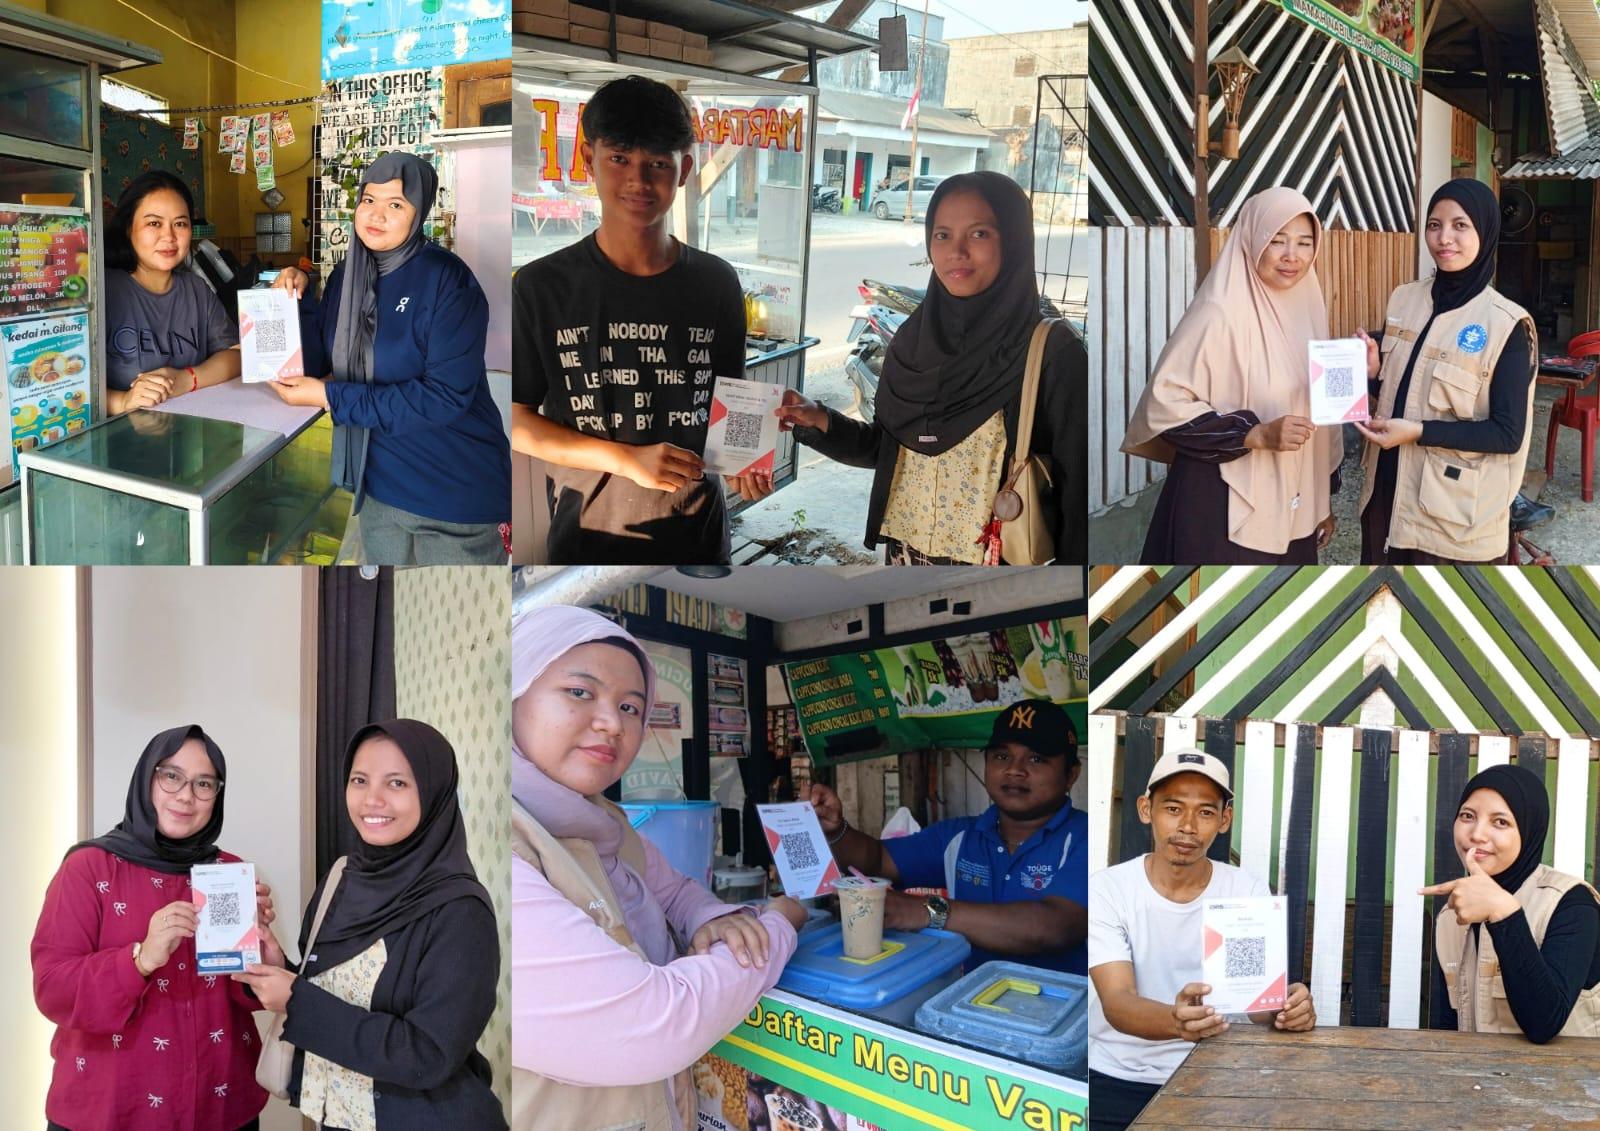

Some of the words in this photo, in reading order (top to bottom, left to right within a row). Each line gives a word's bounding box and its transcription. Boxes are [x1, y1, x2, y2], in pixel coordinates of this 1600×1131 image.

[1293, 0, 1326, 26] MAMAH
[1326, 16, 1351, 42] NABIL
[345, 78, 378, 101] THIS
[382, 71, 432, 96] OFFICE
[354, 102, 380, 111] ARE
[345, 113, 369, 127] ARE
[361, 122, 424, 149] RESPECT
[329, 227, 349, 246] Co
[18, 292, 46, 302] MELON
[8, 328, 39, 343] kedai
[556, 326, 590, 346] AIN'T
[608, 322, 669, 341] NOBODY
[559, 351, 582, 369] ME
[600, 346, 613, 363] IN
[638, 346, 667, 363] THA
[565, 375, 572, 391] I
[584, 369, 639, 389] LERNED
[654, 369, 686, 385] THIS
[570, 394, 595, 412] DAY
[634, 392, 653, 408] BY
[636, 413, 654, 431] BY
[1009, 705, 1036, 729] NY
[1027, 865, 1053, 873] TOUGE
[743, 1001, 843, 1058] Daftar
[853, 1033, 970, 1106] Menu
[986, 1075, 1088, 1131] Var
